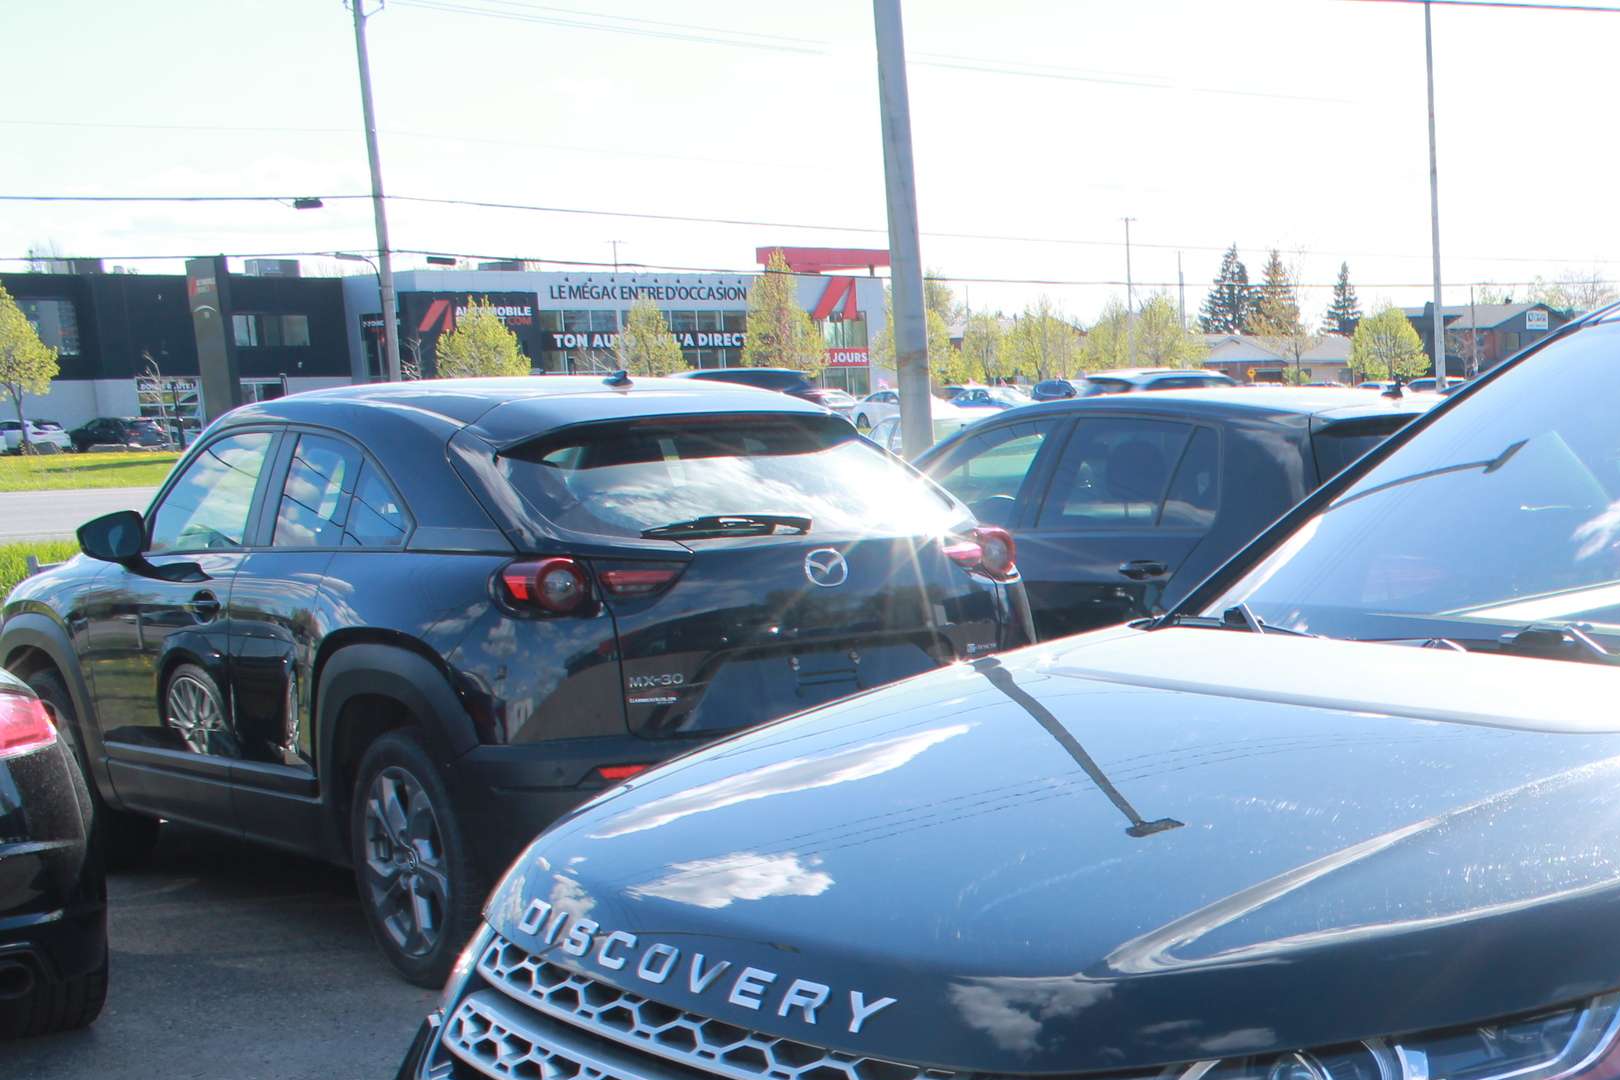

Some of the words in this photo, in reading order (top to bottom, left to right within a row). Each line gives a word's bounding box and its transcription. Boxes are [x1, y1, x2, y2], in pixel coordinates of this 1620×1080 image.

[550, 285, 567, 300] LE
[665, 286, 747, 300] D'OCCASION
[553, 333, 589, 348] TON
[832, 351, 868, 363] JOURS
[629, 673, 684, 688] MX-30
[517, 898, 899, 1033] DISCOVERY
